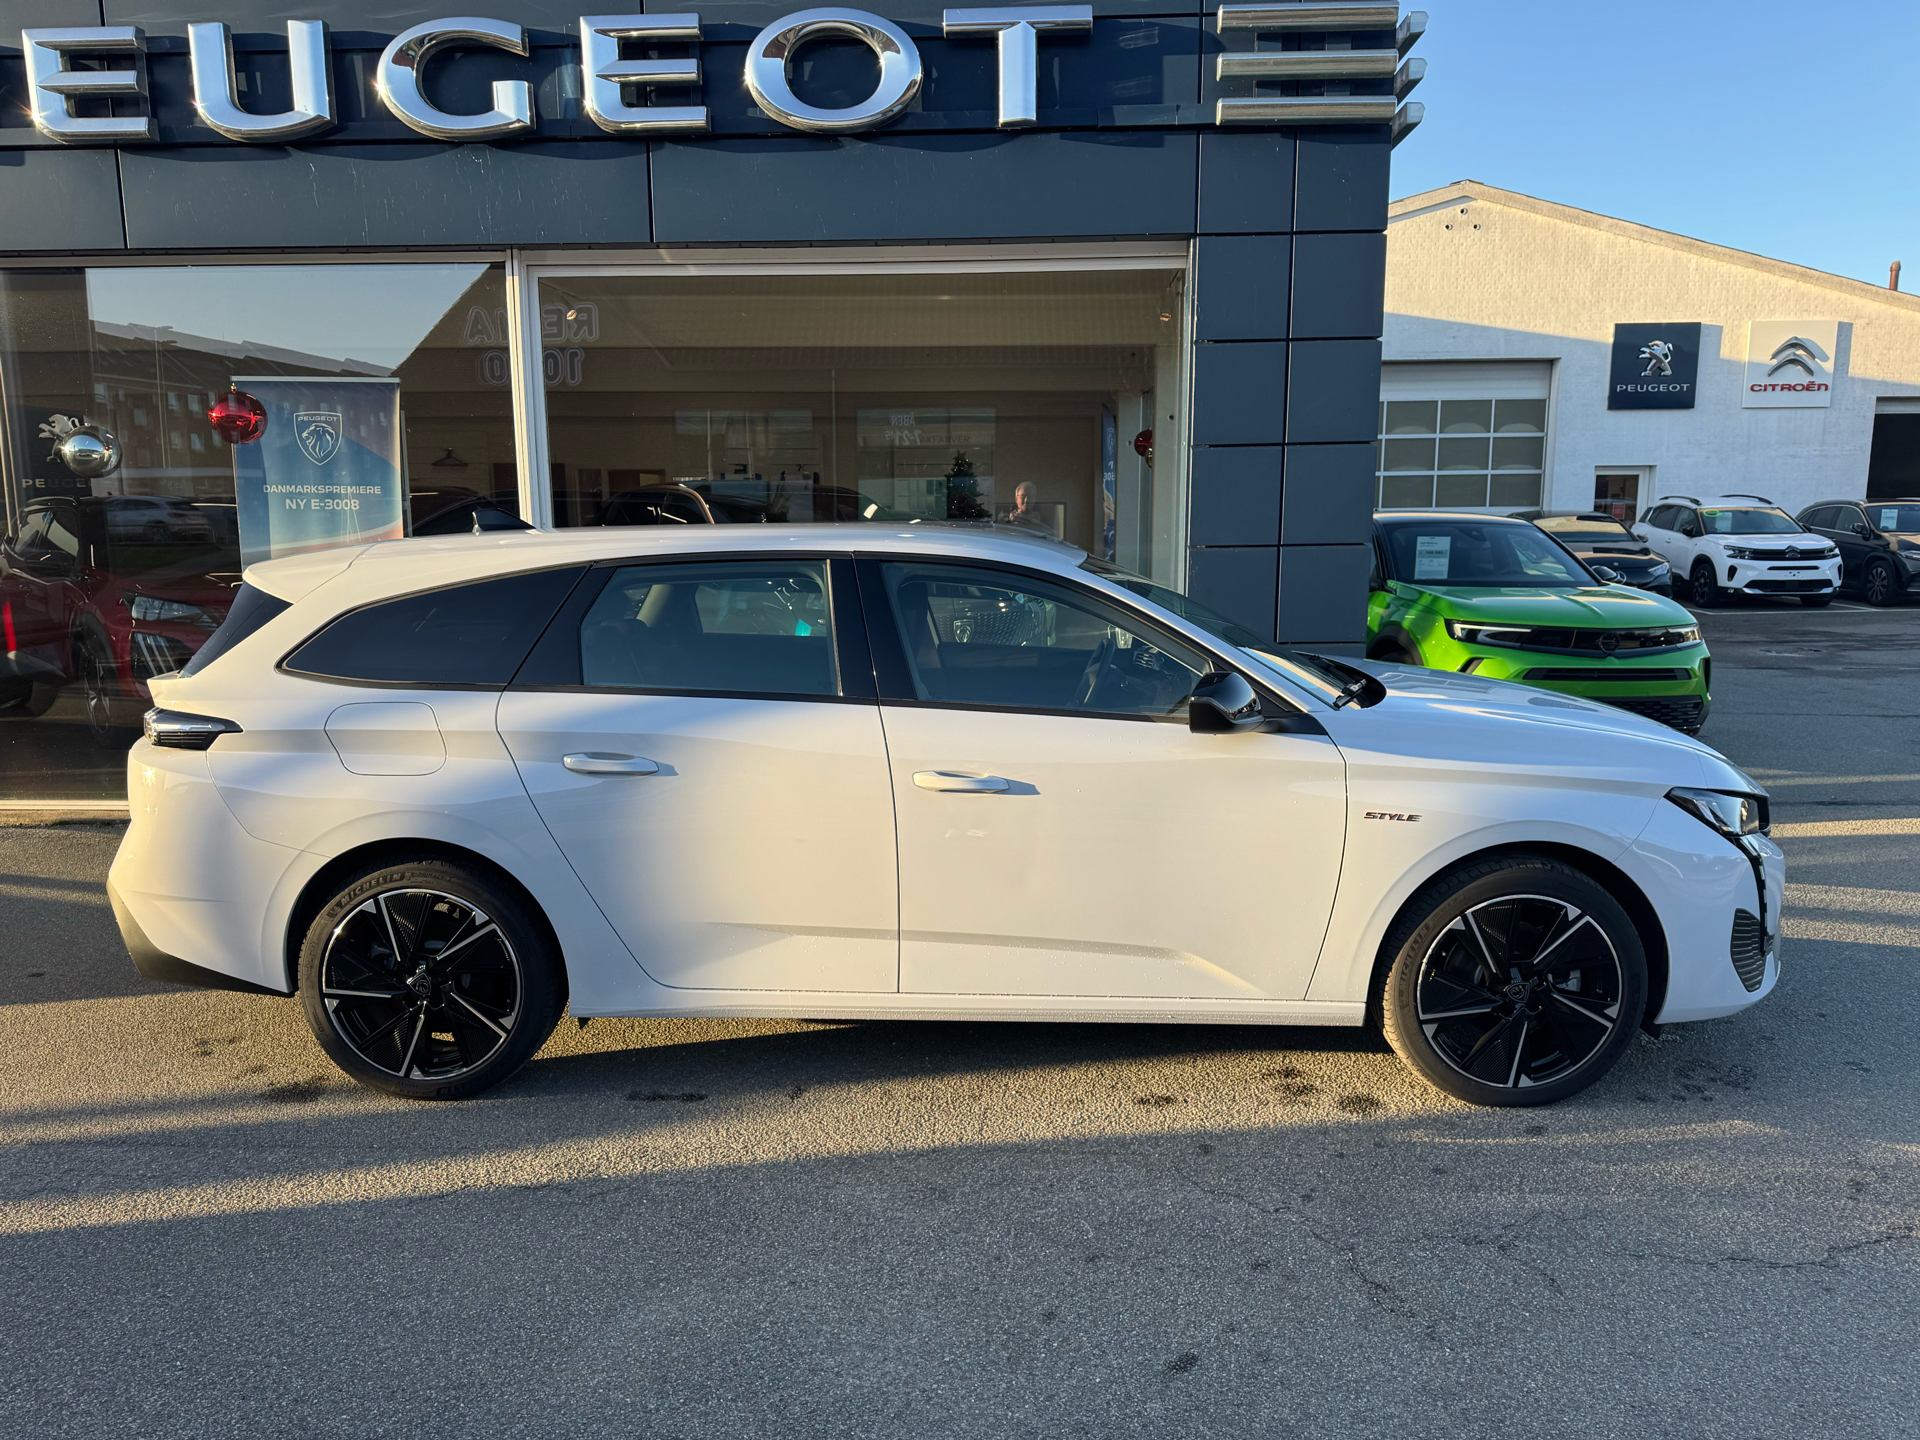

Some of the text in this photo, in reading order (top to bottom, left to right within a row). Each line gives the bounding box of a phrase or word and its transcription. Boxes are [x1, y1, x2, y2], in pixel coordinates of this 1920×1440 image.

[21, 4, 1094, 143] EUGEOT
[1617, 383, 1690, 393] PEUGEOT
[1750, 380, 1829, 392] CITROËN
[918, 435, 971, 444] AKFARVER
[22, 478, 91, 489] PEUGE
[263, 484, 382, 494] DANMARKSPREMIERE
[285, 498, 360, 511] NY E-3008
[1363, 811, 1423, 822] STYLE
[340, 872, 402, 906] MICHELIN
[1399, 926, 1429, 991] MICHELIN
